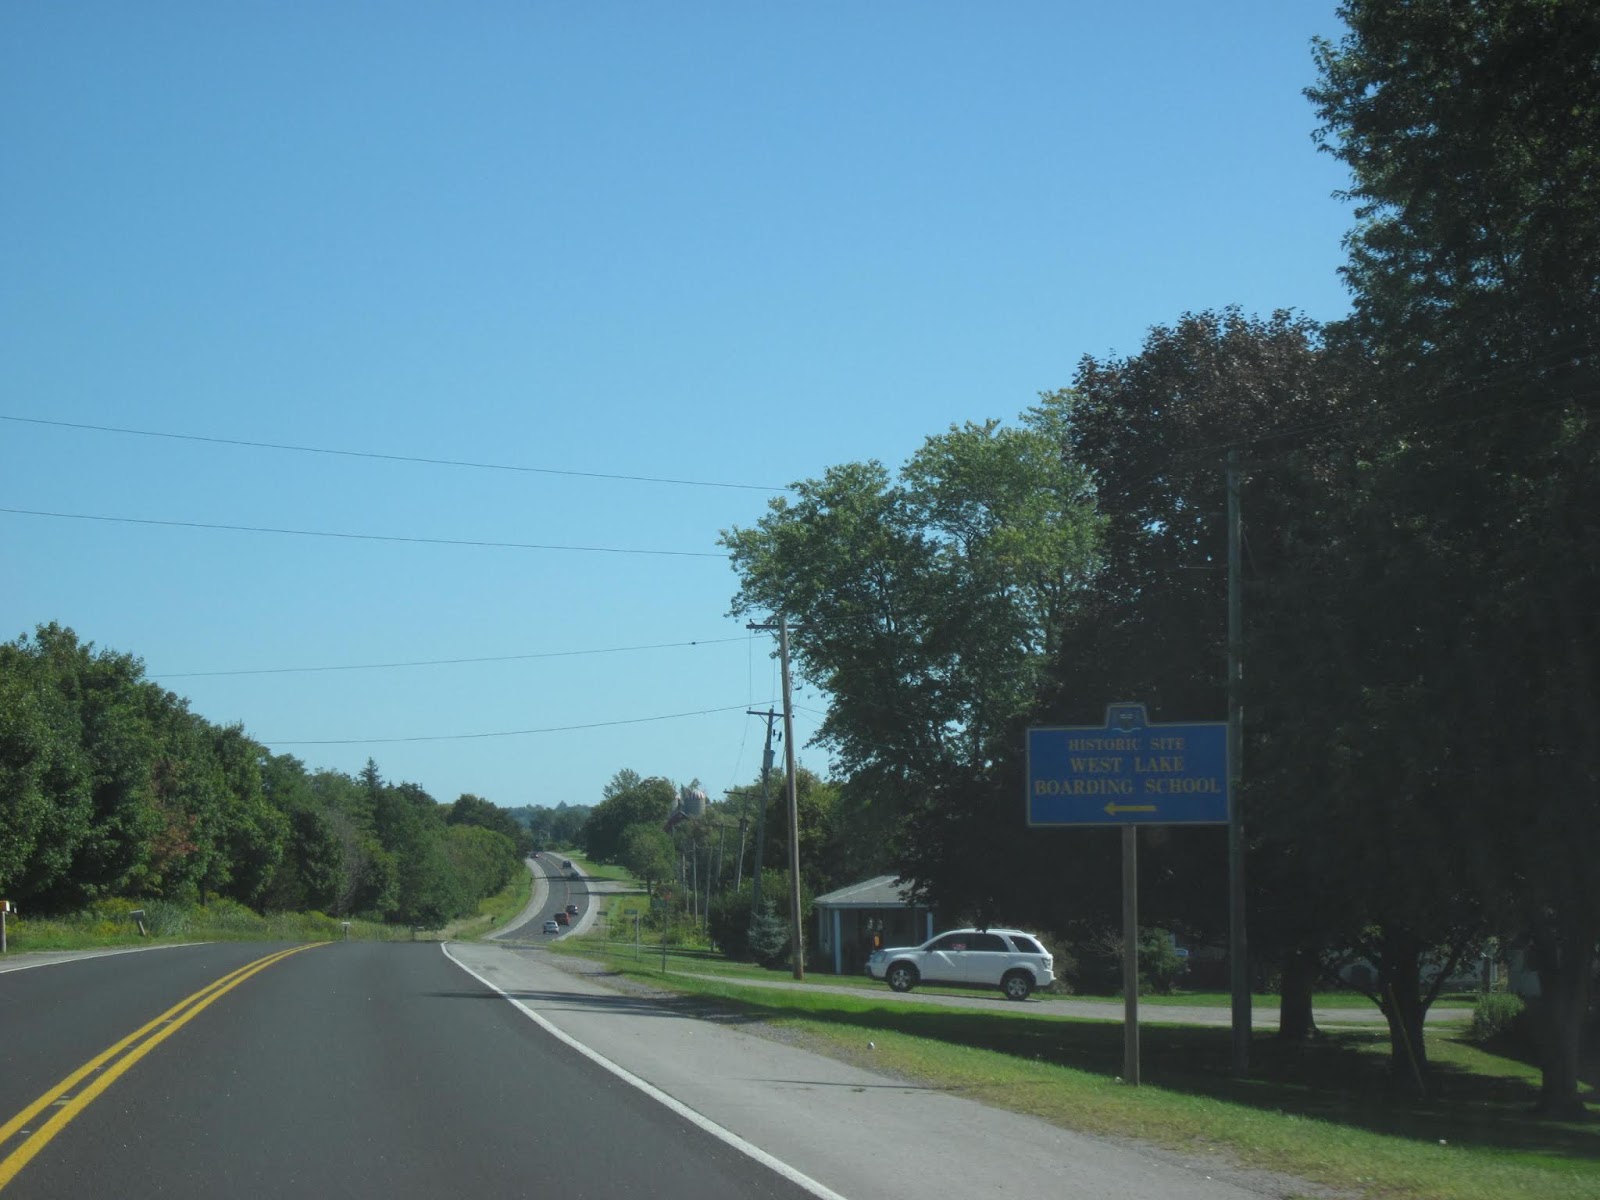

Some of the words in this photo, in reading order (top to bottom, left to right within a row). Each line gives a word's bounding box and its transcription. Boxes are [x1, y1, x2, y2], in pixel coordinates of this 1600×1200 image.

[1069, 737, 1142, 752] HISTORIC
[1151, 737, 1184, 751] SITE
[1070, 757, 1122, 773] WEST
[1135, 756, 1184, 772] LAKE
[1034, 779, 1133, 795] BOARDING
[1145, 777, 1221, 793] SCHOOL
